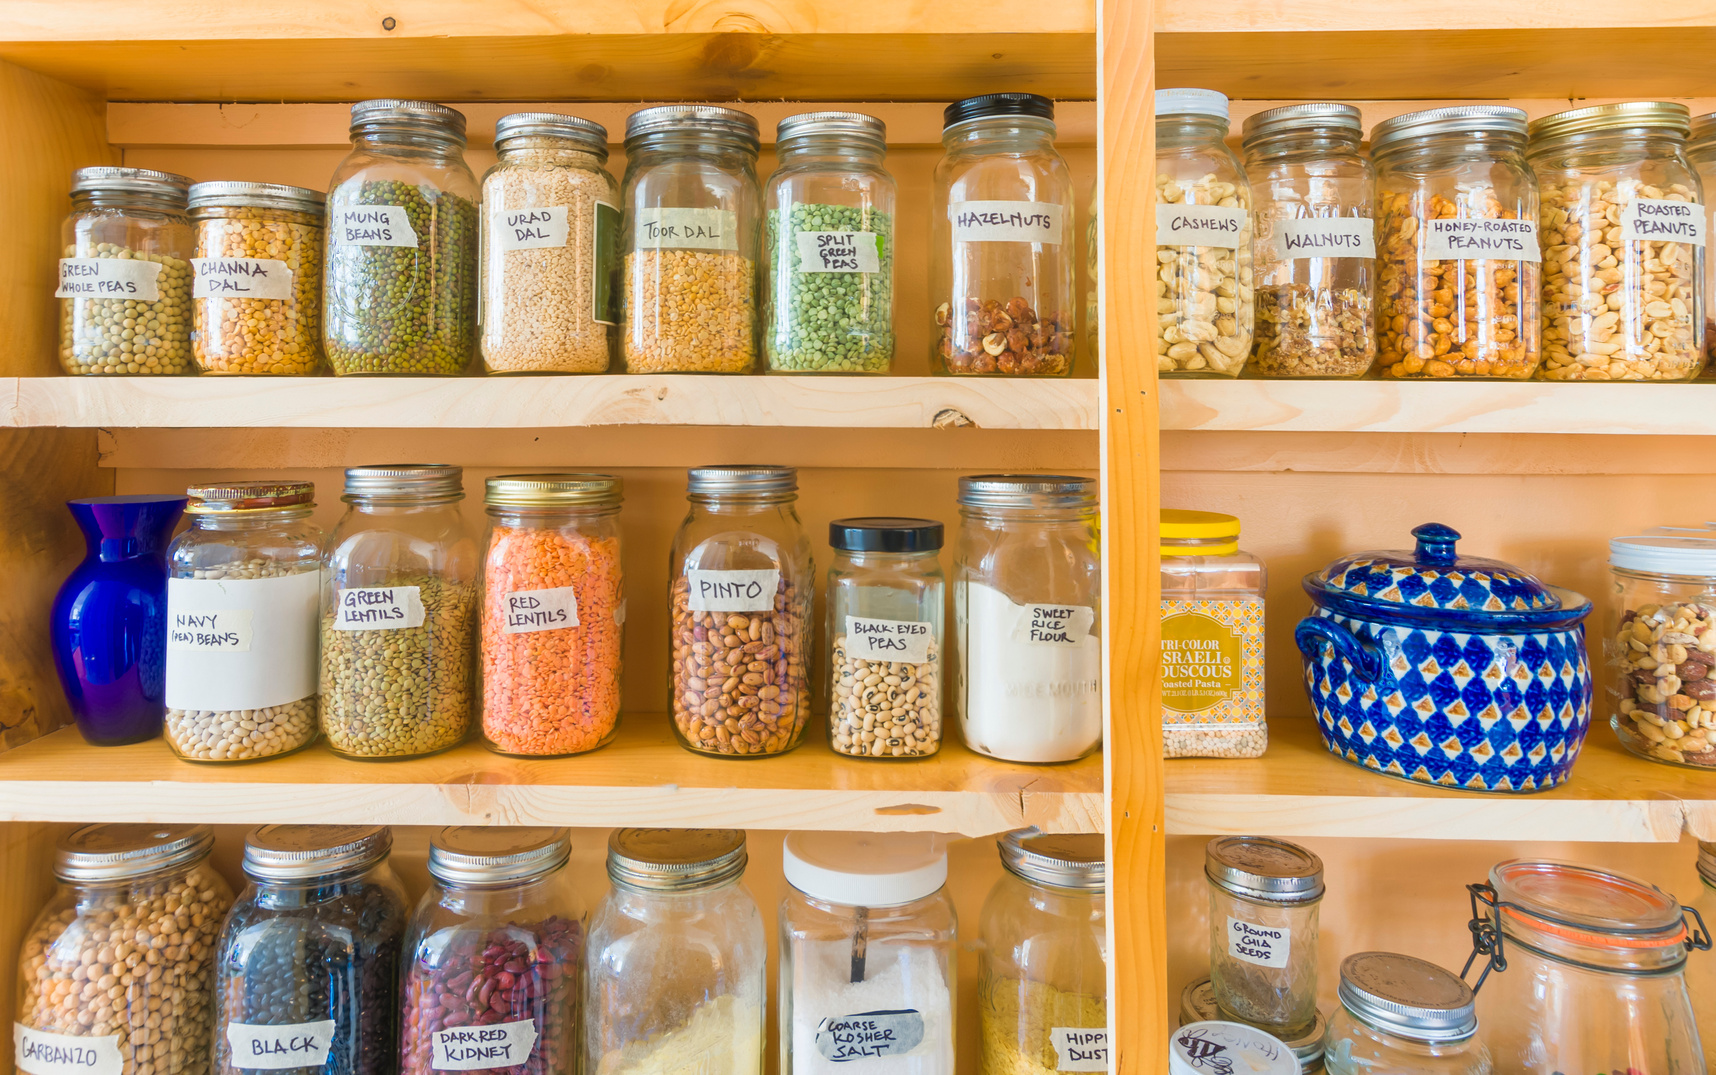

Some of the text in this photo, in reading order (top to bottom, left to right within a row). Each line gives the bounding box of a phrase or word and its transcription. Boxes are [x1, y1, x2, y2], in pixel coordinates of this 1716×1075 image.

[1638, 203, 1691, 217] ROASTED
[345, 212, 390, 226] MUNG
[508, 212, 552, 228] URAD
[957, 211, 1051, 229] HAZELNUTS
[1171, 216, 1238, 233] CASHEWS
[643, 221, 720, 239] TOOR DAL
[1434, 221, 1531, 233] HONEY-ROASTED
[1634, 219, 1697, 237] PEANUTS
[346, 228, 392, 241] BEANS
[515, 228, 550, 241] DAL
[817, 235, 854, 247] SPLIT
[1285, 233, 1361, 250] WALNUTS
[1448, 235, 1523, 250] PEANUTS
[820, 247, 856, 258] GREEN
[62, 262, 98, 277] GREEN
[202, 261, 268, 277] CHANNA
[823, 258, 858, 269] PEAS
[62, 280, 137, 293] WHOLE PEAS
[209, 279, 250, 292] DAL
[700, 579, 762, 598] PINTO
[345, 590, 394, 607] GREEN
[509, 597, 541, 609] RED
[345, 607, 404, 622] LENTILS
[509, 609, 568, 626] LENTILS
[1033, 607, 1075, 619] SWEET
[176, 614, 218, 627] NAVY
[1032, 620, 1065, 630] RICE
[197, 632, 240, 646] BEANS
[868, 636, 907, 651] PEAS
[1030, 630, 1075, 643] FLOUR
[1161, 640, 1219, 650] TRI-COLOR
[1163, 652, 1221, 664] SRAELI
[1161, 665, 1232, 678] OUSCOUS
[1162, 680, 1221, 688] oasted Pasta
[1233, 921, 1282, 940] GROUND
[1242, 936, 1272, 949] CHIA
[1235, 943, 1272, 960] SEEDS
[828, 1021, 877, 1032] COARSE
[440, 1029, 508, 1044] DARK RED
[832, 1029, 897, 1044] KOSHER
[1067, 1033, 1107, 1045] HIPPI
[22, 1036, 97, 1067] GARBANZO
[252, 1036, 320, 1055] BLACK
[444, 1043, 513, 1062] KIDNEY
[833, 1044, 890, 1058] SALT
[1068, 1048, 1108, 1064] DUST
